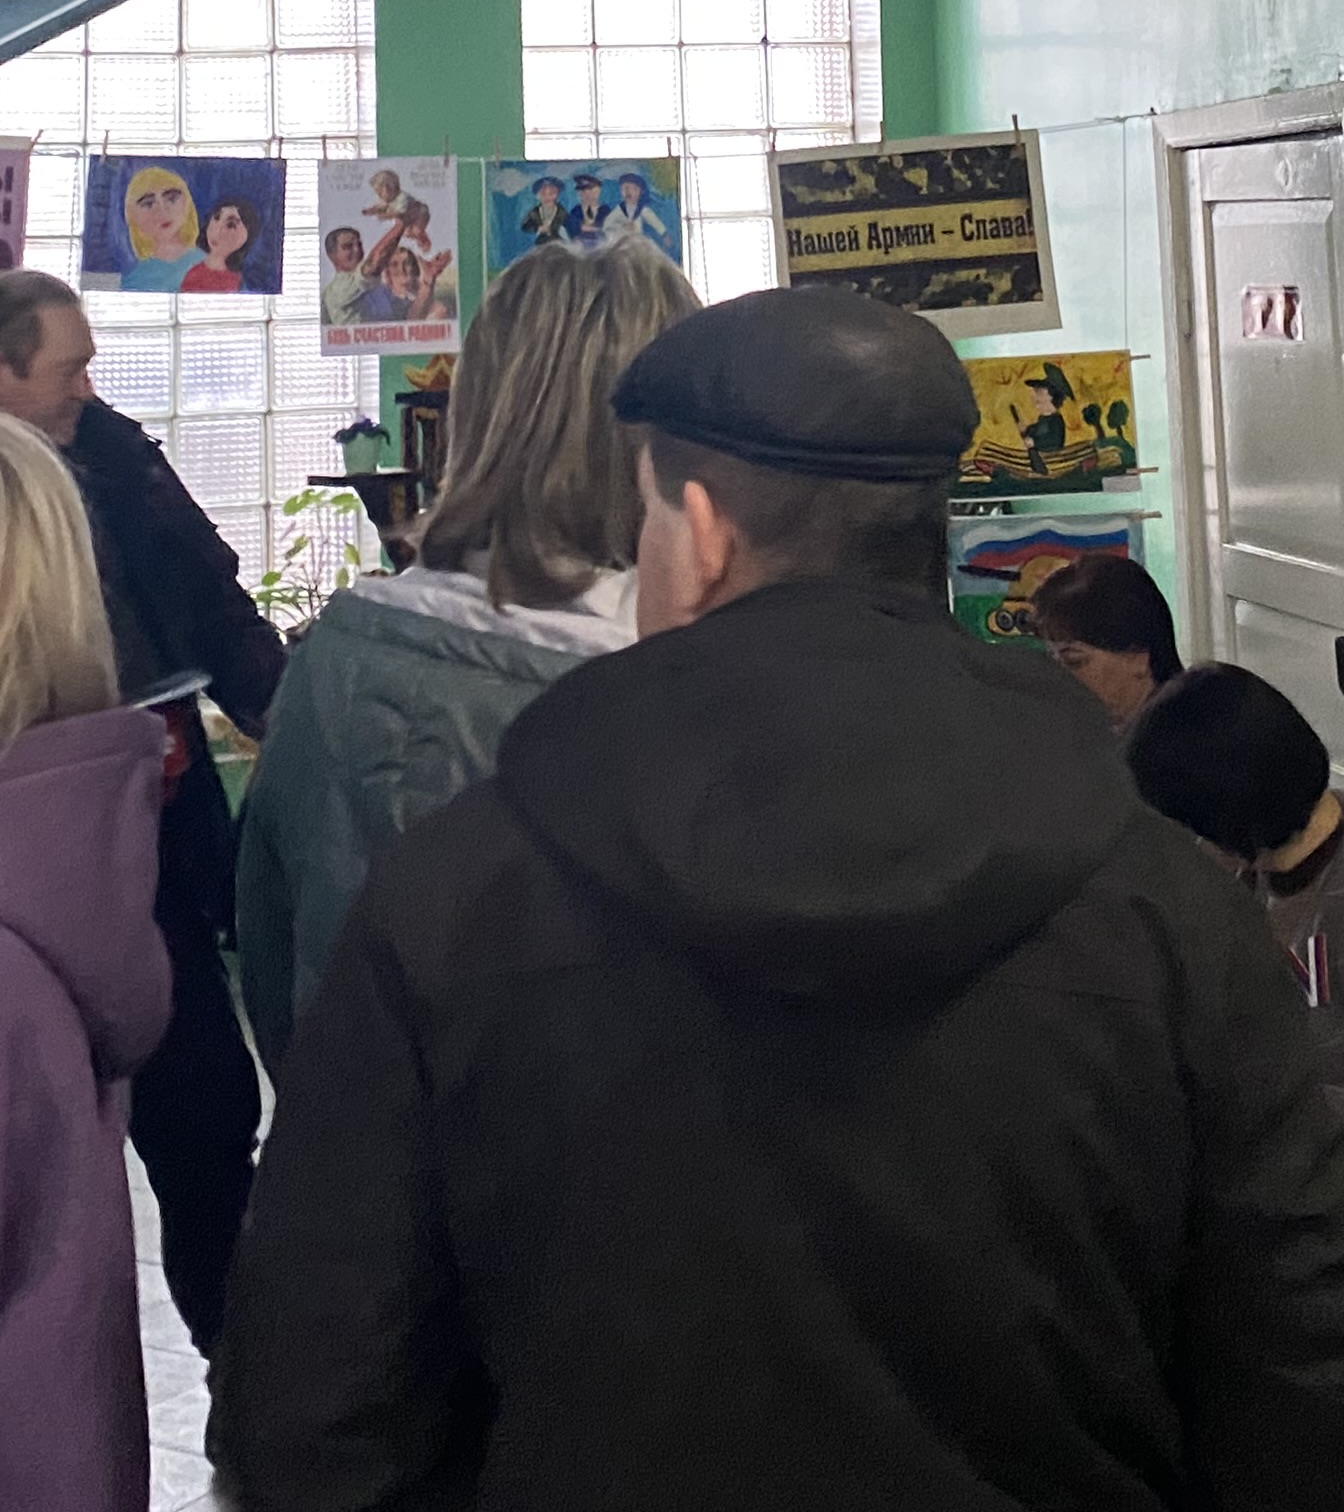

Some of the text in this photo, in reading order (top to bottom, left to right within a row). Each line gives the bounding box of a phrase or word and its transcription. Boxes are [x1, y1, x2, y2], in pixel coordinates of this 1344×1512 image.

[786, 225, 861, 258] Нашей
[867, 221, 936, 255] Армии
[959, 208, 1035, 242] Слава!
